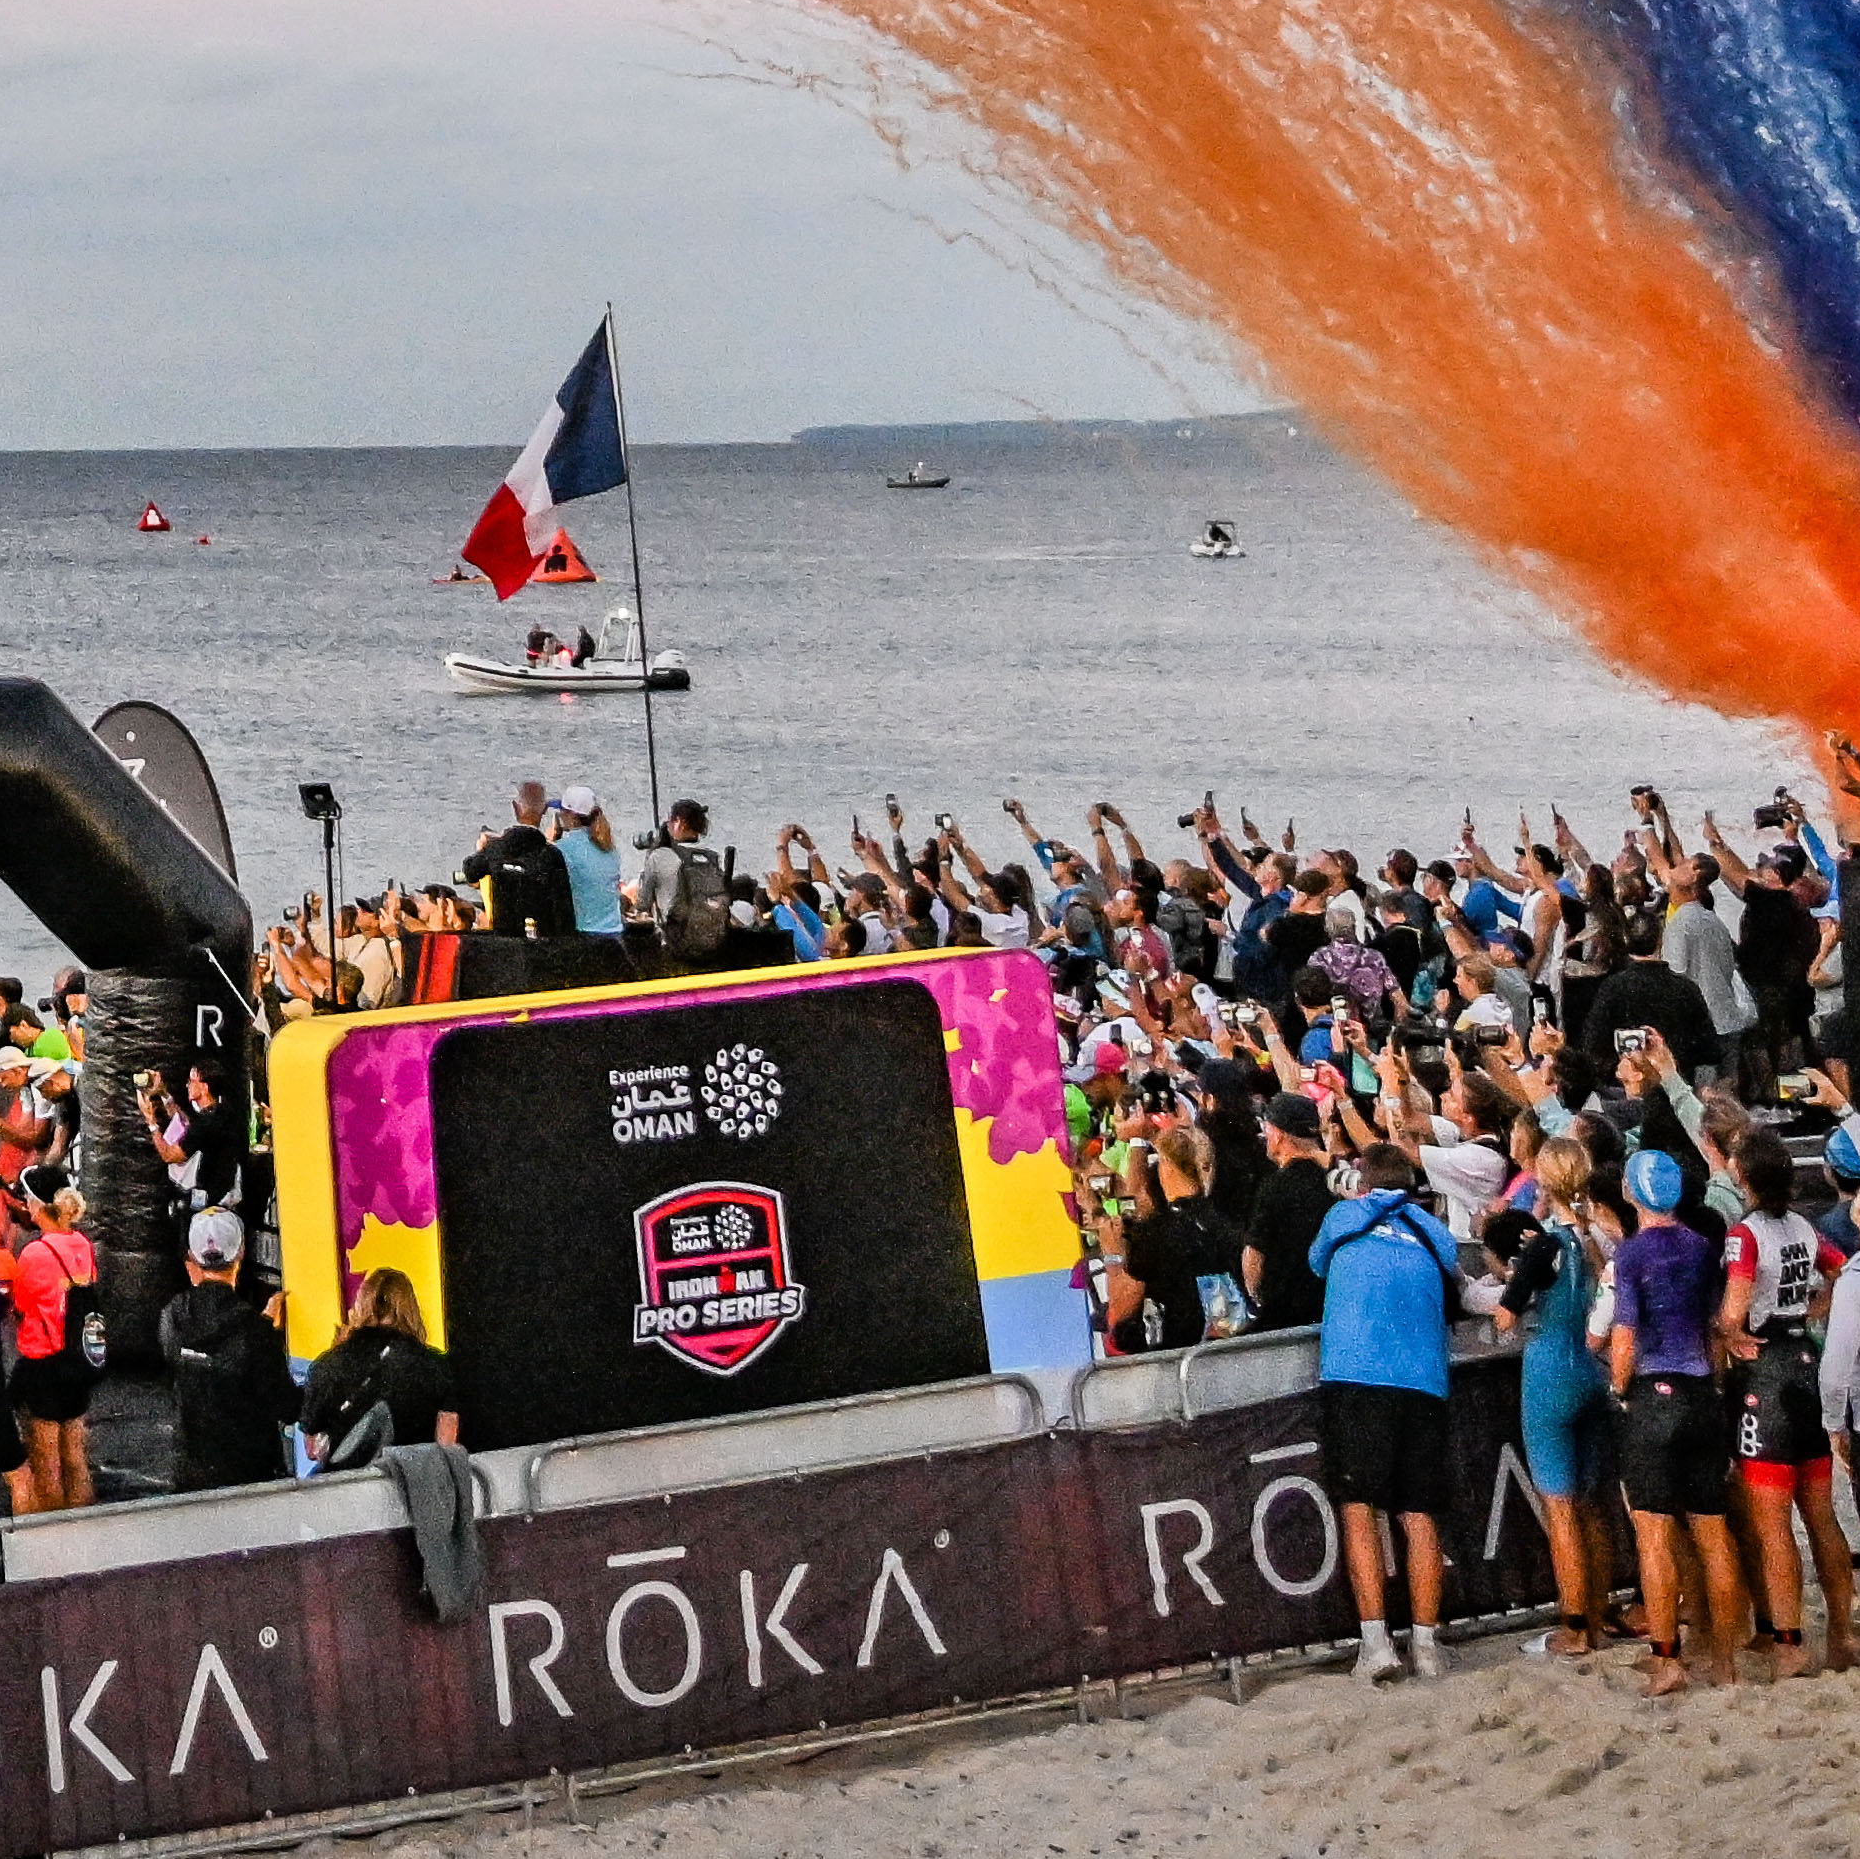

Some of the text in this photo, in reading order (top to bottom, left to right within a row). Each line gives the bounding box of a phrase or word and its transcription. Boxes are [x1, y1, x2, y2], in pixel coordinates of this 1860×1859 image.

[609, 1065, 690, 1087] Experience
[612, 1111, 696, 1143] OMAN
[672, 1237, 713, 1253] OMAN
[640, 1289, 799, 1334] PRO SERIES
